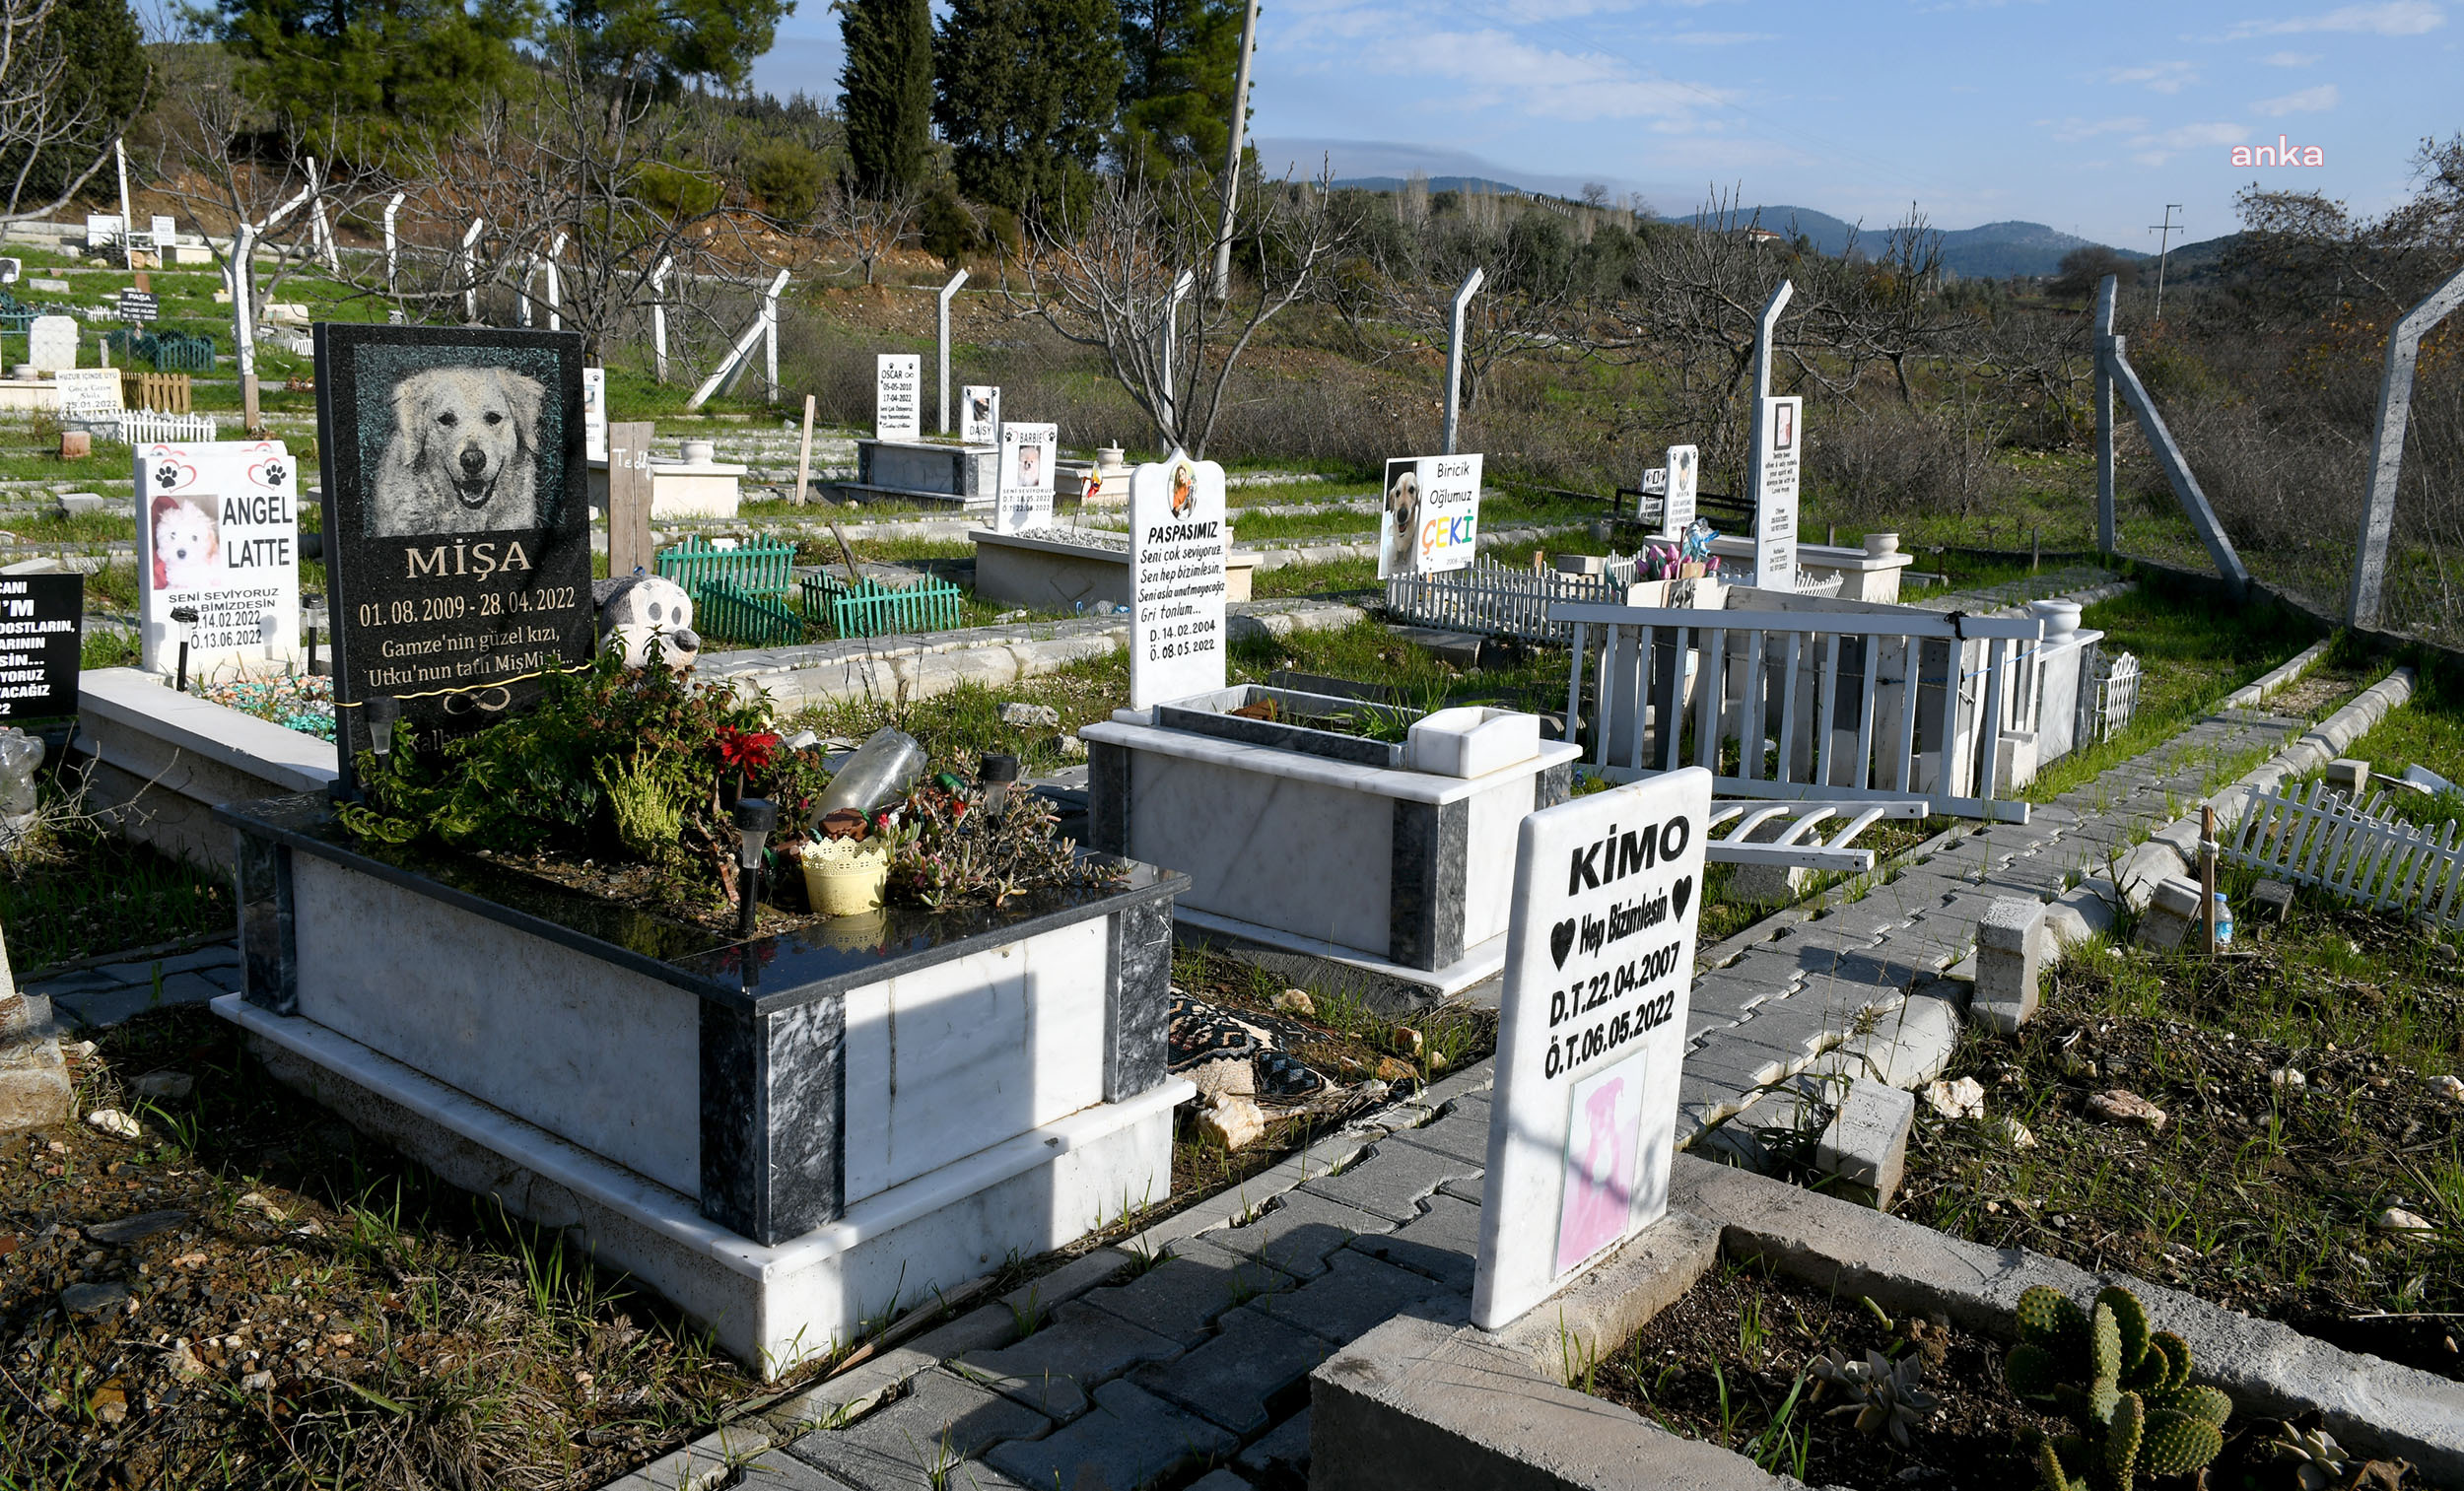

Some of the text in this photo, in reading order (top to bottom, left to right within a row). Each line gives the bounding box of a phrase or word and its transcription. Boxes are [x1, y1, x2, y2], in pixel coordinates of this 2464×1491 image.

[881, 370, 903, 379] OSCAR
[1020, 431, 1043, 443] BARBİE
[1437, 461, 1470, 478] Biricik
[1429, 489, 1472, 508] Oğlumuz
[223, 496, 293, 525] ANGEL
[1147, 521, 1218, 545] PASPASIMIZ
[1421, 508, 1473, 556] ÇEKİ
[228, 538, 290, 569] LATTE
[404, 538, 533, 582] MİŞA
[1140, 548, 1162, 564] Seni
[1164, 545, 1181, 565] çok
[1140, 561, 1222, 583] Sen hep bizimlesin.
[0, 581, 28, 594] ANI
[169, 588, 280, 603] SENİ SEVİYORUZ
[1137, 587, 1157, 603] Seni
[1156, 584, 1173, 599] asla
[1140, 607, 1157, 623] Gri
[381, 633, 474, 658] Gamze'nin
[479, 626, 523, 653] güzel
[369, 664, 451, 687] Utku'nun
[1568, 815, 1690, 897] KİMO
[1579, 886, 1668, 959] Hep Bizimlesin
[1549, 940, 1680, 1028] D.T.22.04.2007
[1544, 989, 1676, 1080] Ö.T.06.05.2022
